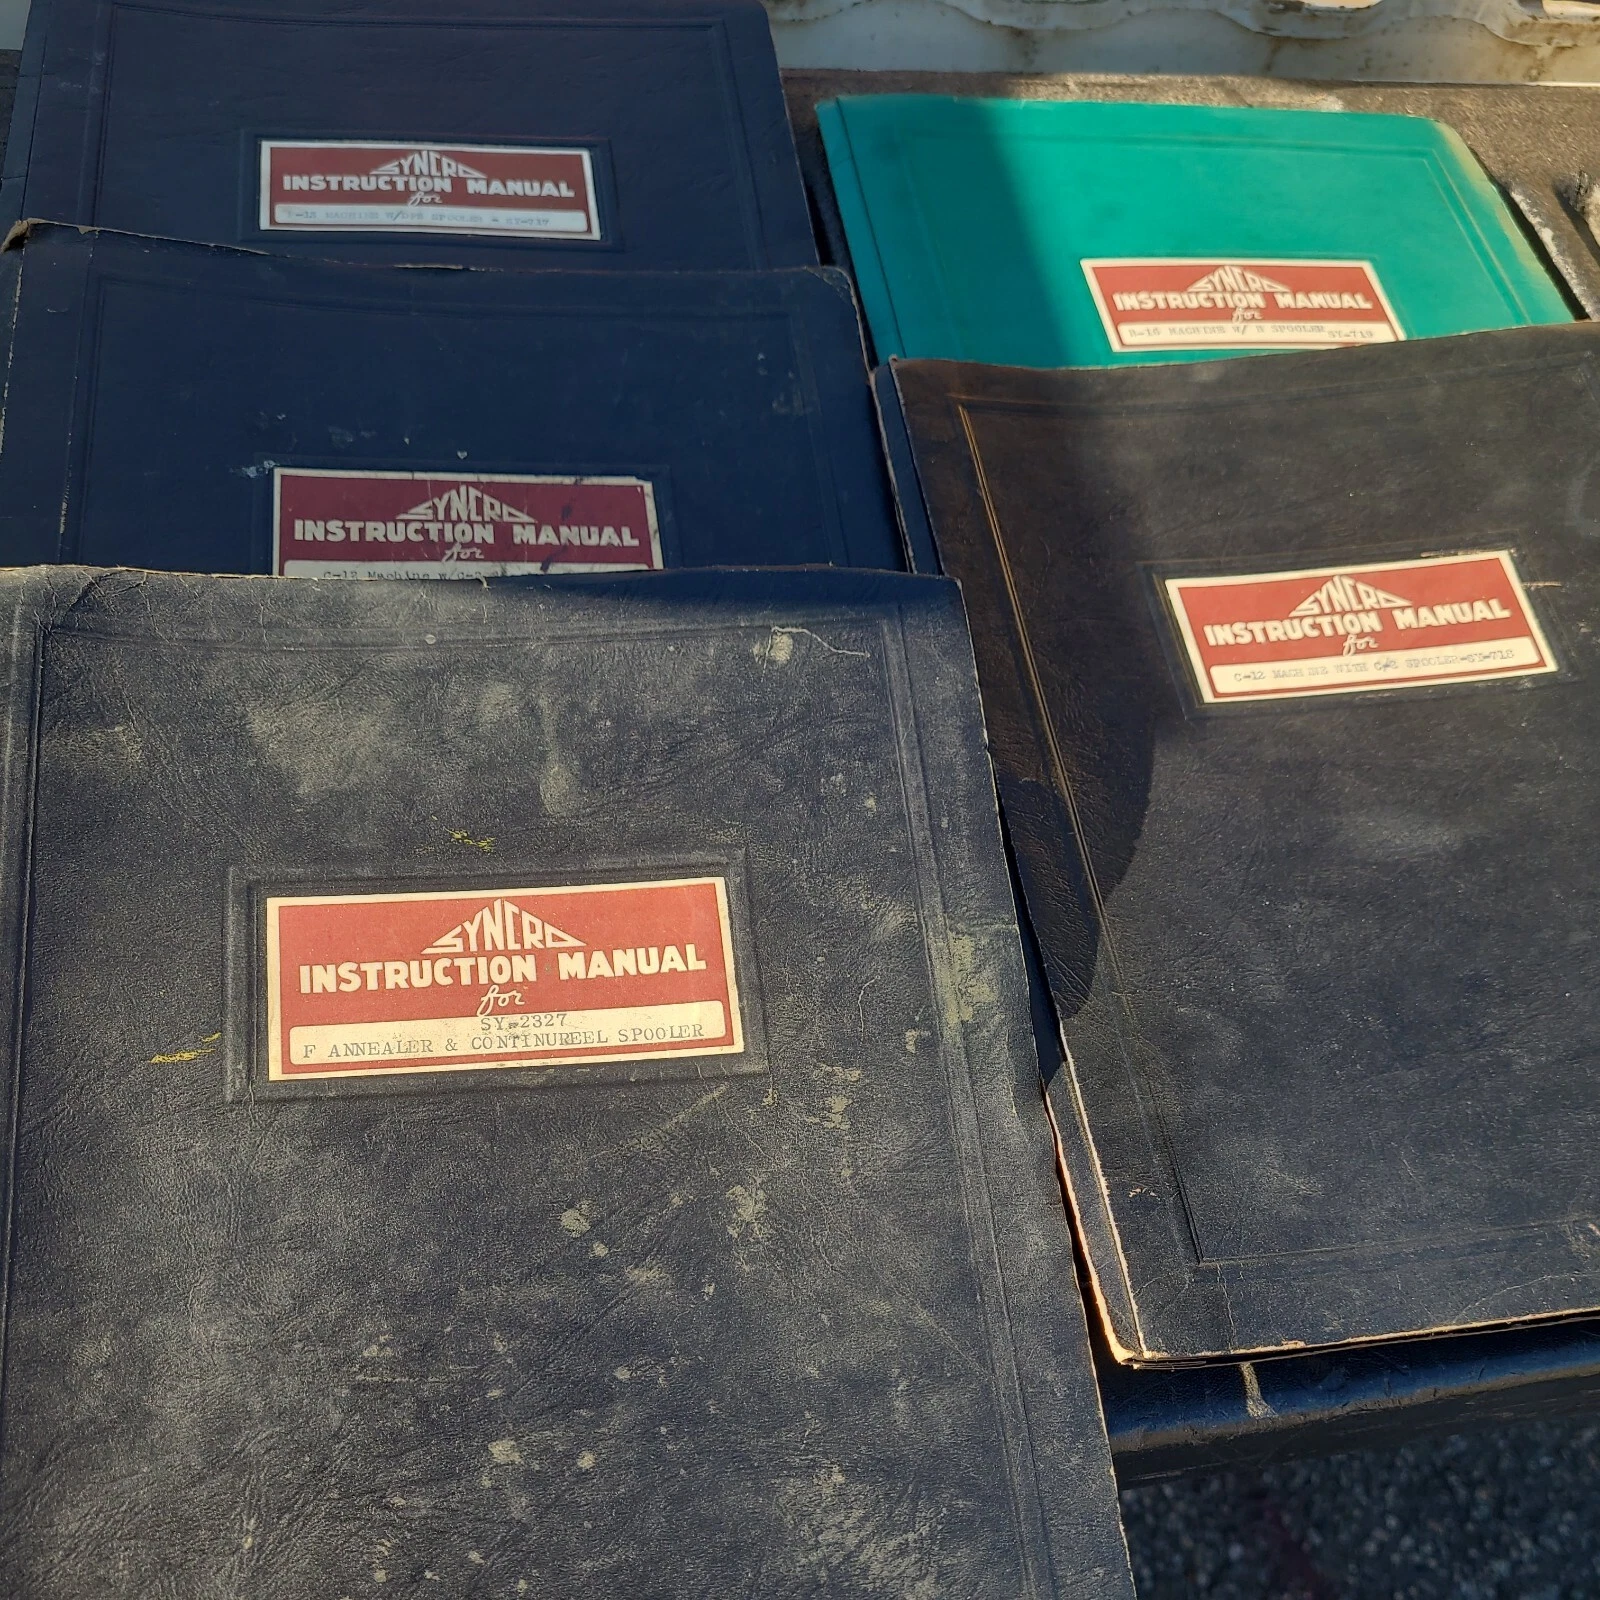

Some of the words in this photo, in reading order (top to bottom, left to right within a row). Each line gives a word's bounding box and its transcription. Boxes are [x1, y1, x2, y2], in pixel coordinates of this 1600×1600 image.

[369, 150, 488, 179] SYNCRO
[282, 175, 452, 193] INSTRUCTION
[466, 178, 576, 198] MANUAL
[407, 191, 443, 207] for
[1187, 264, 1292, 293] SYNCRO
[1112, 291, 1266, 312] INSTRUCTION
[1273, 291, 1374, 310] MANUAL
[1231, 306, 1264, 324] for
[1167, 325, 1227, 338] MACHINE
[1271, 323, 1327, 334] SPOOLER
[396, 484, 538, 524] SYNCRO
[294, 518, 495, 544] INSTRUCTION
[512, 523, 640, 548] MANUAL
[441, 542, 485, 563] for
[1287, 574, 1414, 618] SYNCRO
[1203, 611, 1384, 647] INSTRUCTION
[1391, 598, 1513, 630] MANUAL
[1342, 633, 1380, 656] for
[1233, 671, 1266, 683] C-12
[1335, 661, 1369, 675] WITH
[421, 898, 587, 954] SYNCRO
[299, 954, 537, 994] INSTRUCTION
[557, 943, 707, 980] MANUAL
[477, 984, 525, 1017] for
[480, 1012, 568, 1032] SY-2327
[303, 1043, 317, 1059] F
[327, 1038, 434, 1059] ANNEALER
[444, 1037, 458, 1052] &
[471, 1029, 609, 1050] CONTINUREEL
[618, 1023, 705, 1043] SPOOLER
